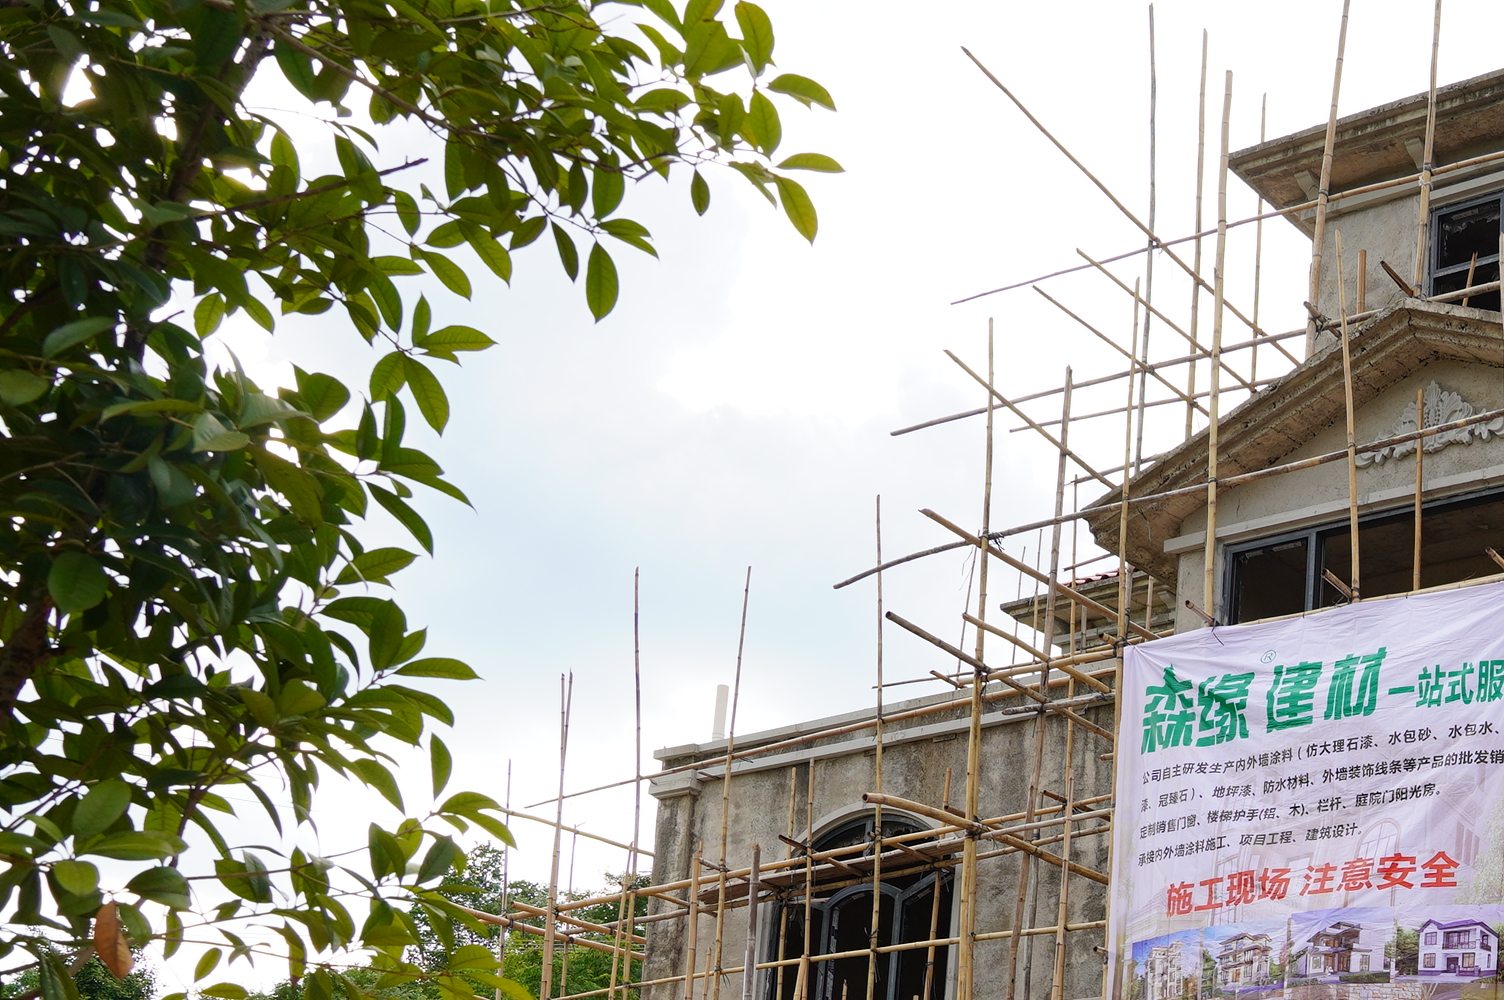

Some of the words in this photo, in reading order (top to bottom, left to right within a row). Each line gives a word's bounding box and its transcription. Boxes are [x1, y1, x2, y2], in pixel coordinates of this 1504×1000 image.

[1166, 867, 1292, 918] 施工现场
[1299, 851, 1460, 897] 注意安全
